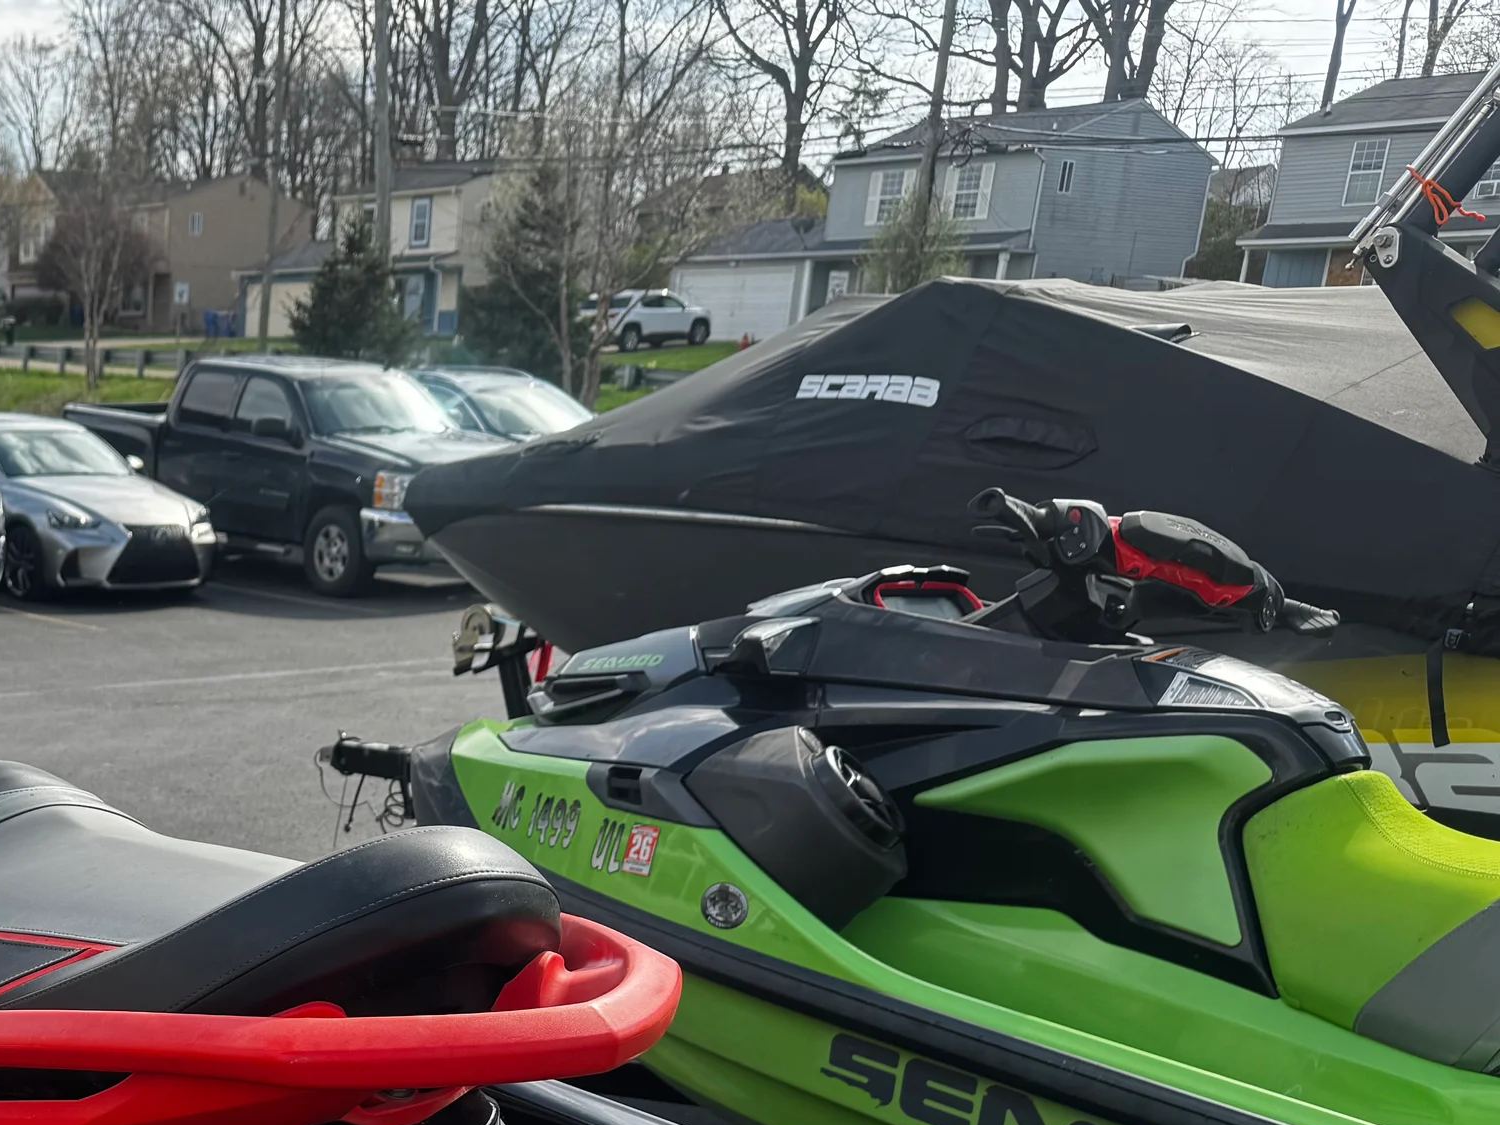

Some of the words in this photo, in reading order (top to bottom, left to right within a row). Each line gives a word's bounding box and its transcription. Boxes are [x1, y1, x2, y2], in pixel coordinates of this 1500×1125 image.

[795, 374, 941, 408] SCARAB
[492, 781, 526, 830] MC
[527, 792, 581, 849] 1499
[591, 817, 626, 874] UL
[628, 833, 654, 861] 26
